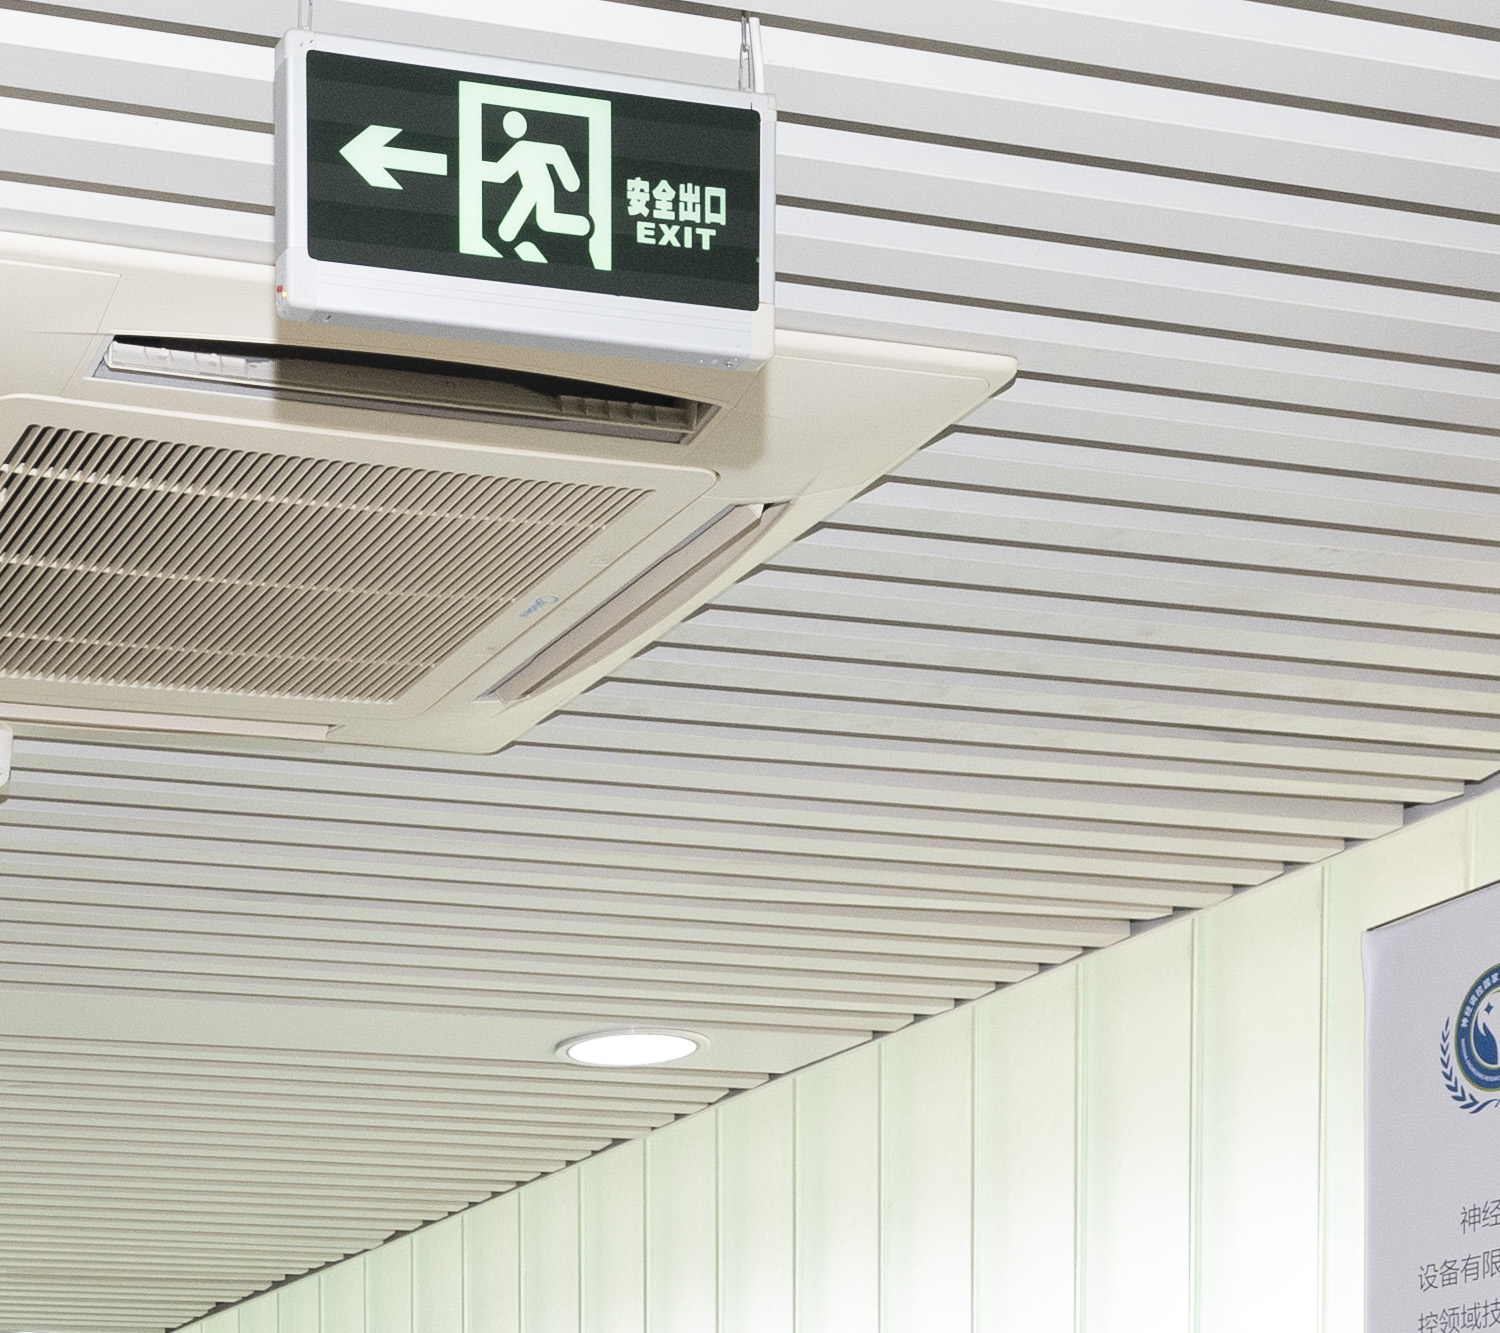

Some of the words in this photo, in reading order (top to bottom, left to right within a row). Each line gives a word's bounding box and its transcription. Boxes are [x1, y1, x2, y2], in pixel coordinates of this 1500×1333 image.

[626, 176, 727, 226] 安全出口
[636, 220, 717, 251] EXIT
